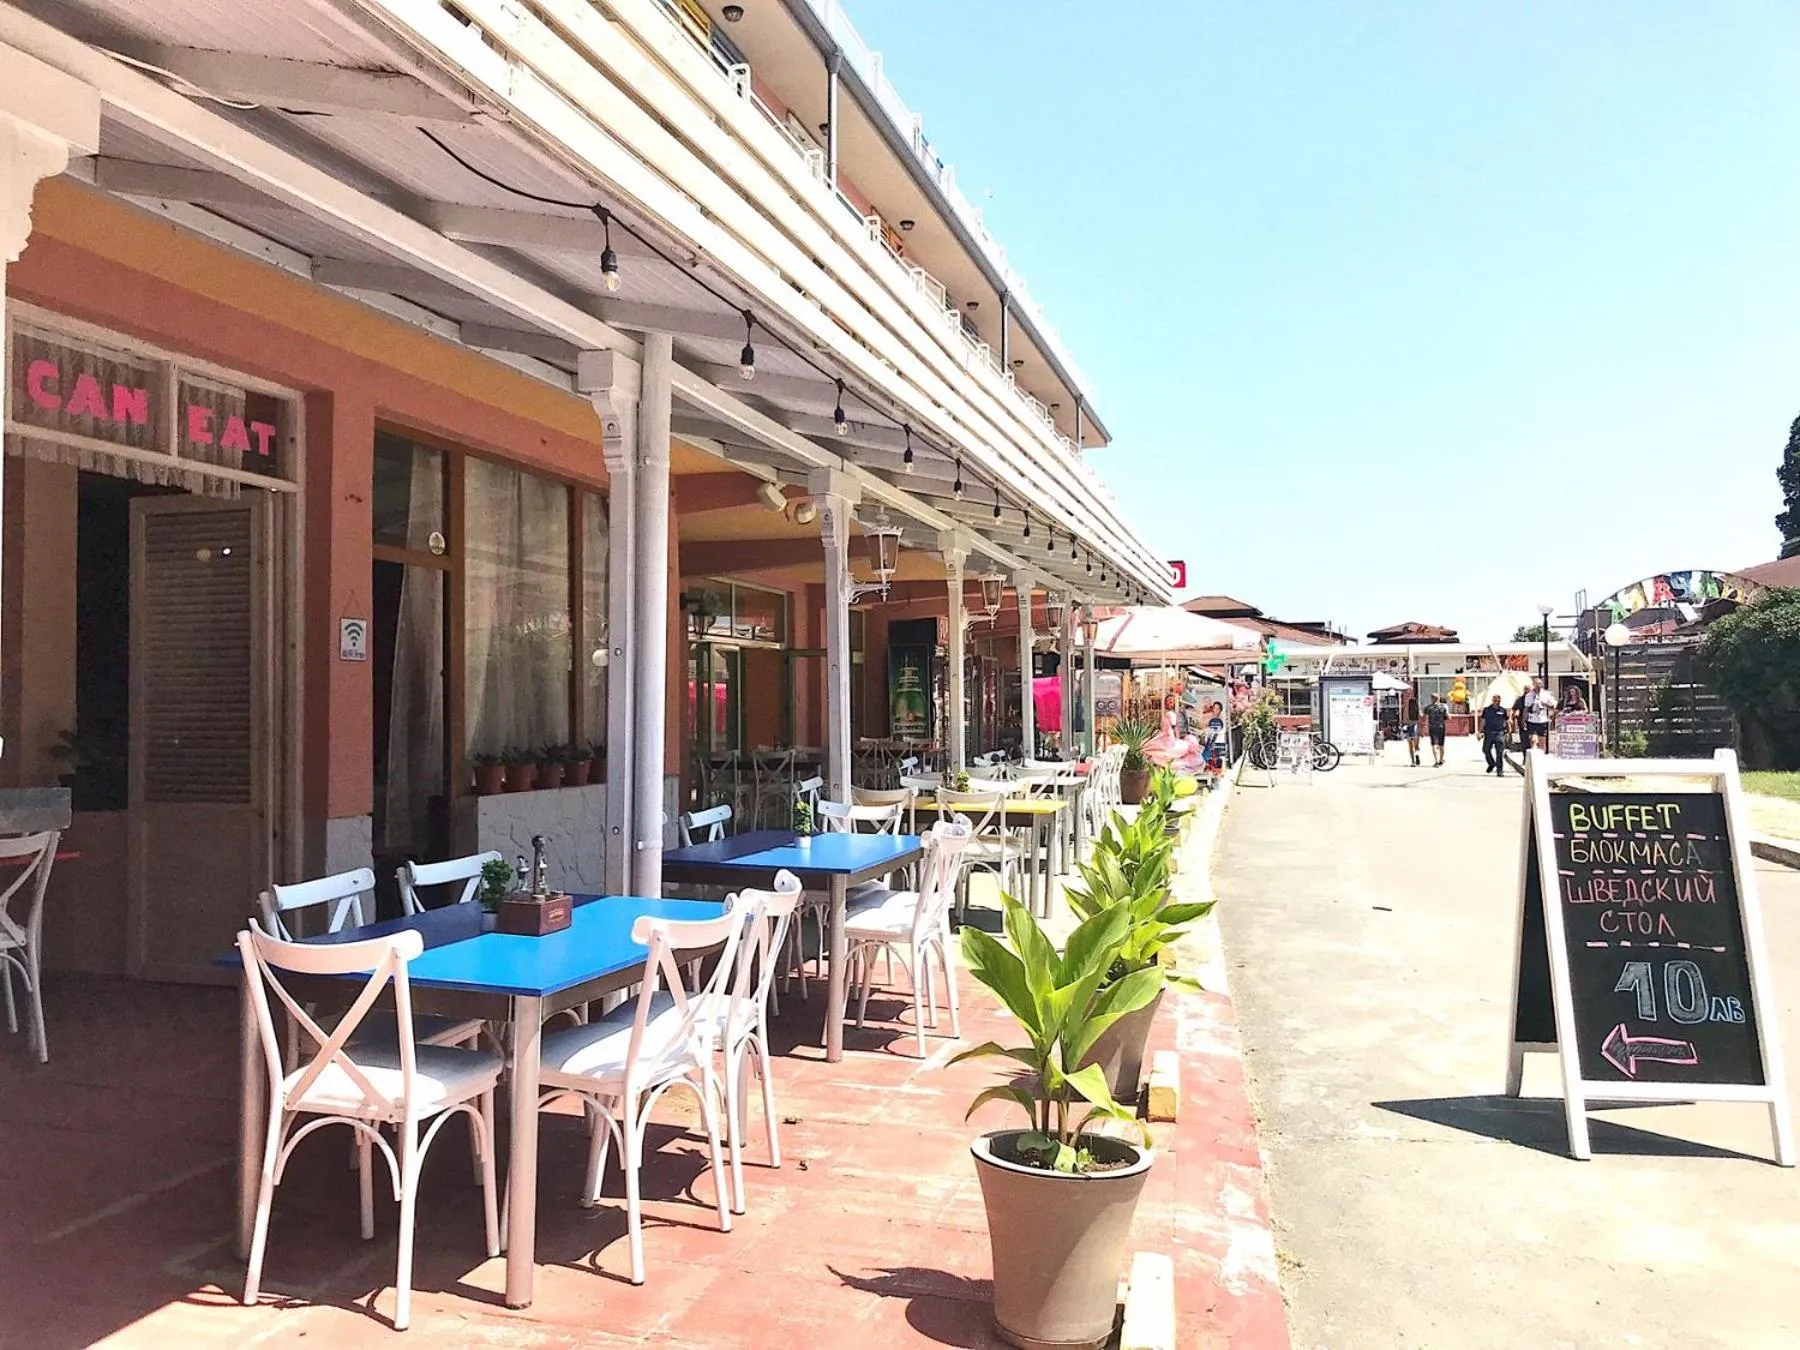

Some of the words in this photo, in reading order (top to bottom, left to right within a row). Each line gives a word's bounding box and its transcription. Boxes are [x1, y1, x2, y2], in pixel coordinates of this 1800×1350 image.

[27, 359, 149, 425] CAN
[187, 404, 277, 456] EAT
[1568, 802, 1681, 832] BUFFET
[1570, 838, 1702, 865] БЛОКМАСА
[1565, 875, 1717, 905] ШВЕДСКИЙ
[1599, 911, 1676, 937] СТОЛ
